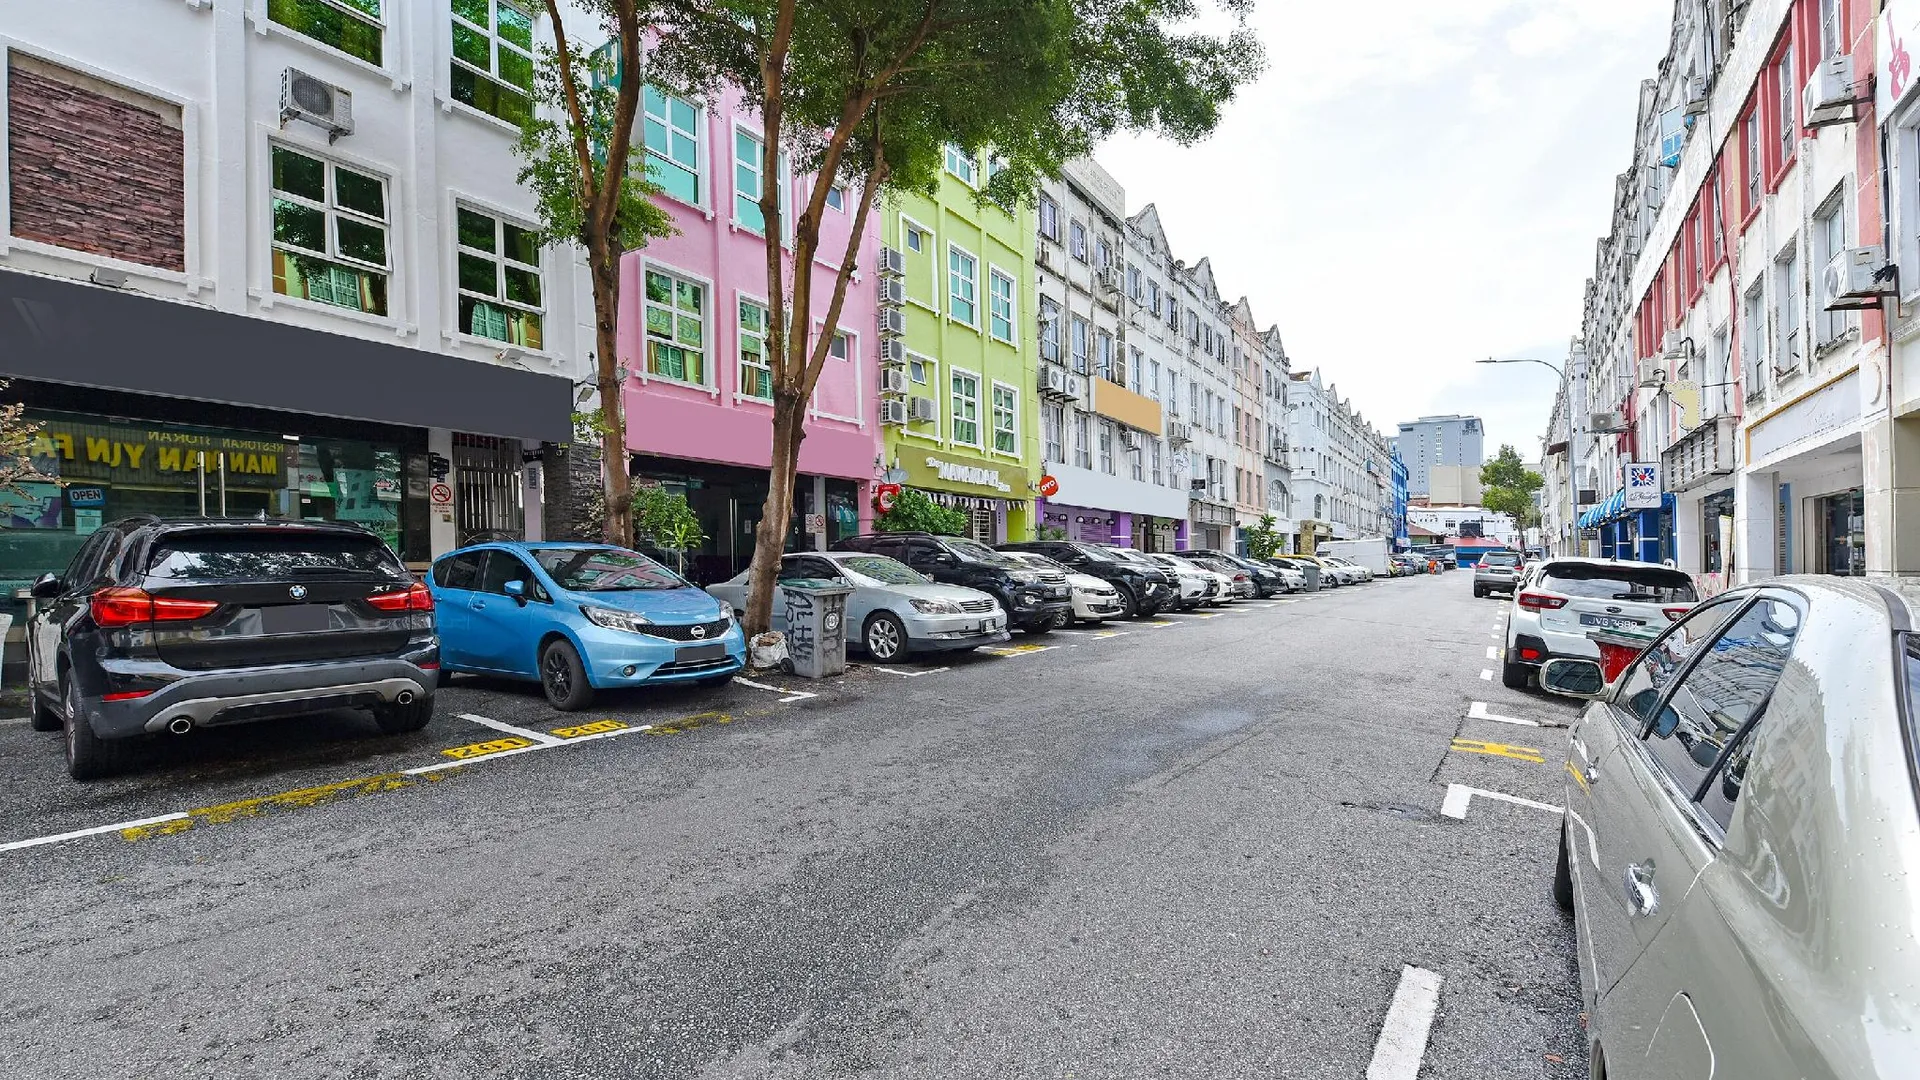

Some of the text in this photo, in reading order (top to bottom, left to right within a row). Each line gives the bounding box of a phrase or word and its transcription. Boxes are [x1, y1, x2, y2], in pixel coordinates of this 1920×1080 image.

[1041, 480, 1056, 491] OYO
[72, 488, 101, 500] OPEN
[371, 584, 391, 592] X1
